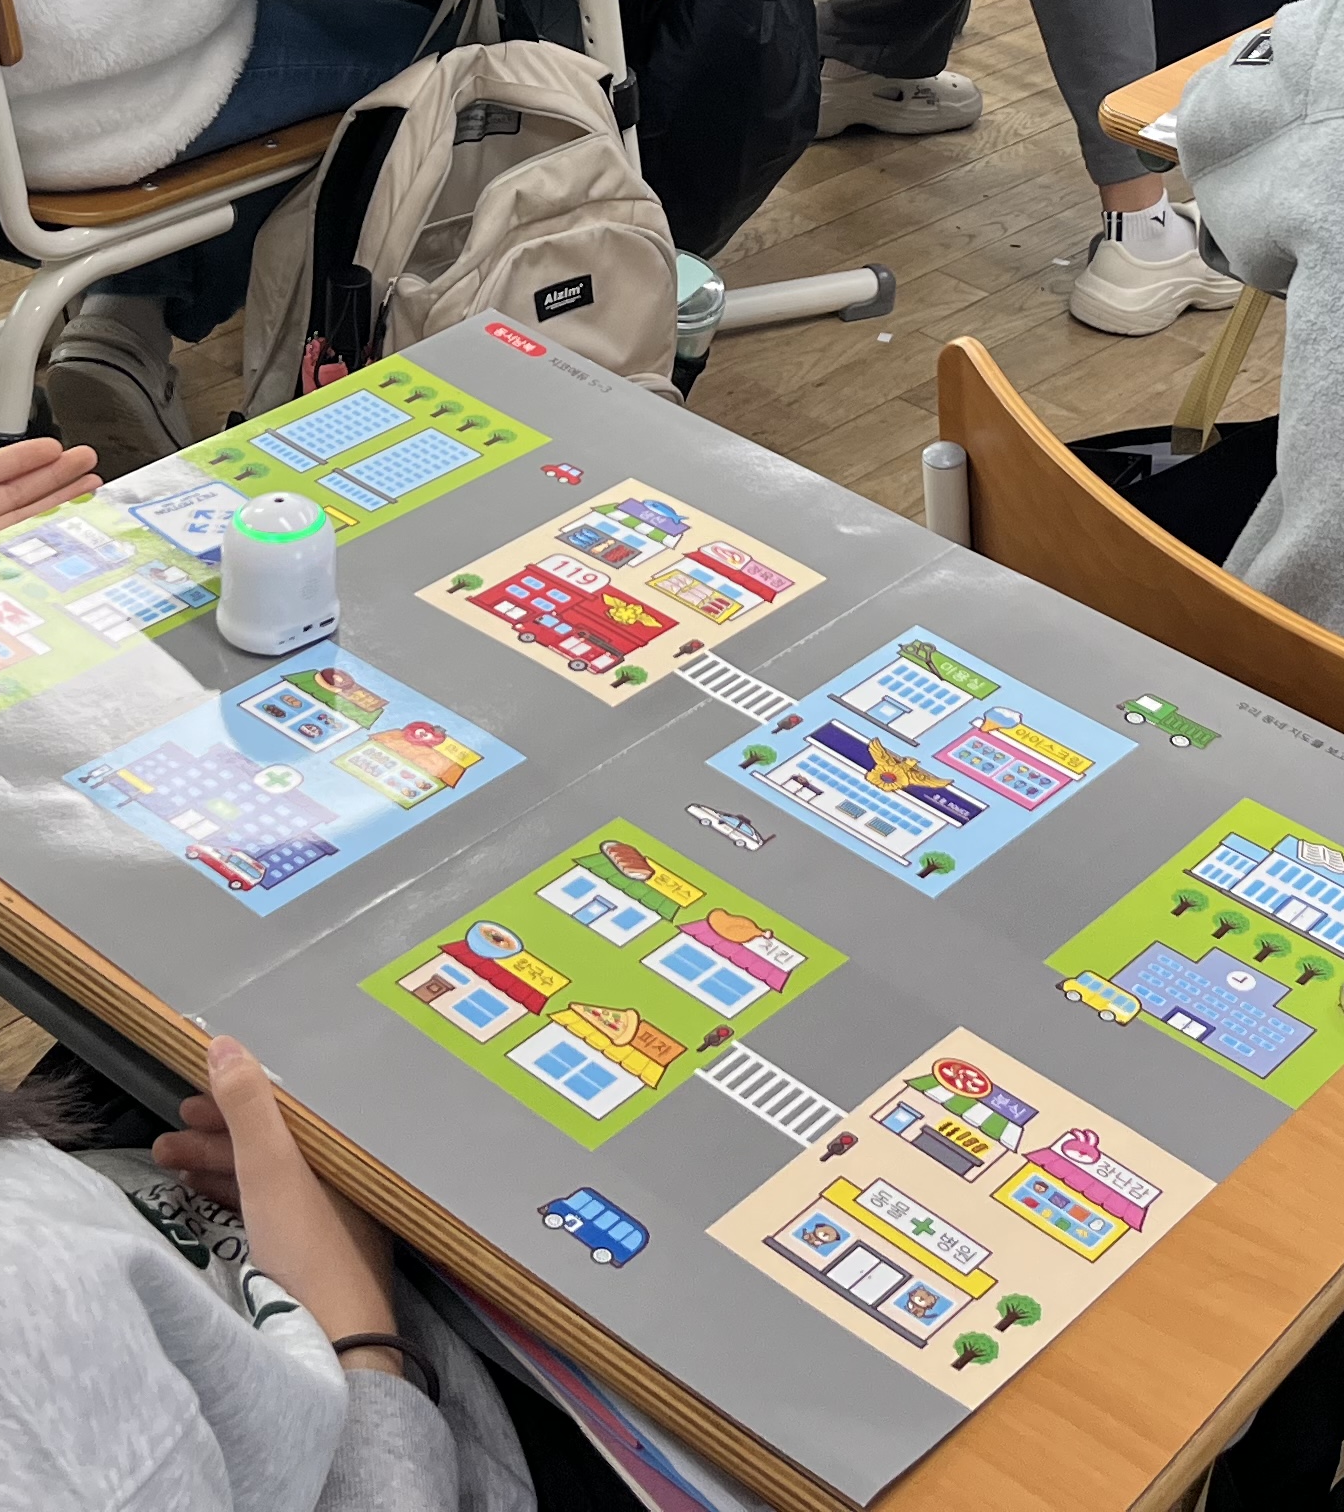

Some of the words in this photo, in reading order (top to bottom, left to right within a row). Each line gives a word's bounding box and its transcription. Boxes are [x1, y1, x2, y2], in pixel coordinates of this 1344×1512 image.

[553, 560, 599, 584] 119
[940, 661, 985, 691] 미용실
[1237, 701, 1262, 718] 우리
[1016, 728, 1083, 768] 아이스크림
[654, 872, 694, 900] 돈가스
[760, 941, 795, 964] 치킨
[637, 1033, 672, 1058] 피자
[991, 1092, 1026, 1119] 분식
[1097, 1159, 1150, 1201] 장난감
[870, 1189, 910, 1220] 동물
[937, 1231, 977, 1265] 병원
